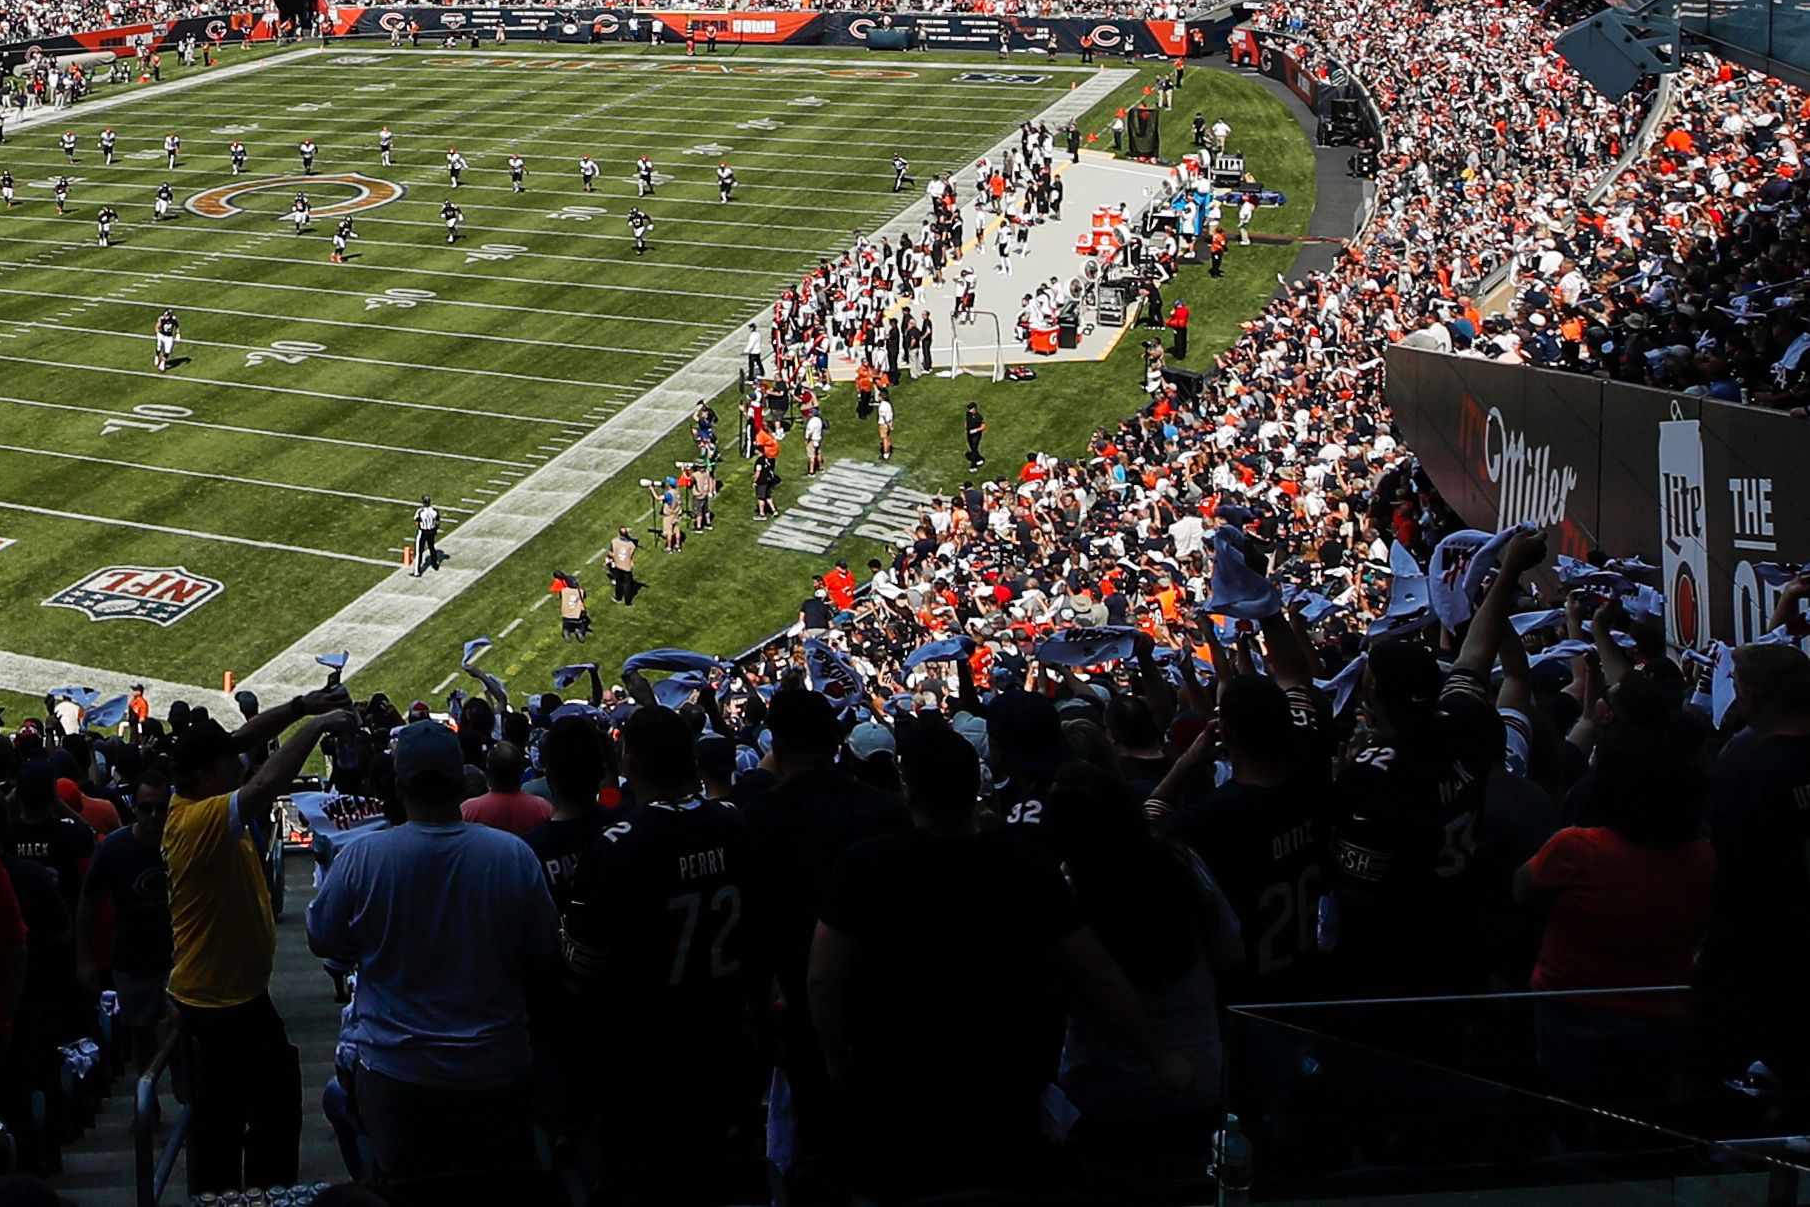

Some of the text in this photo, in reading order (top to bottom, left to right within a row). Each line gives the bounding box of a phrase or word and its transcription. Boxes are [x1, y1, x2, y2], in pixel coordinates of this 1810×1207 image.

[1090, 24, 1121, 47] C
[244, 340, 328, 367] 20
[100, 403, 194, 436] 10
[1485, 406, 1578, 535] Miller
[757, 458, 904, 555] WELCOME
[1662, 472, 1702, 556] Lite
[1728, 477, 1775, 536] THE
[99, 571, 207, 603] NFL
[1354, 746, 1398, 772] 52
[17, 842, 50, 857] MACK
[1271, 819, 1314, 860] ORTIZ
[677, 846, 727, 882] PERRY
[667, 884, 742, 986] 72
